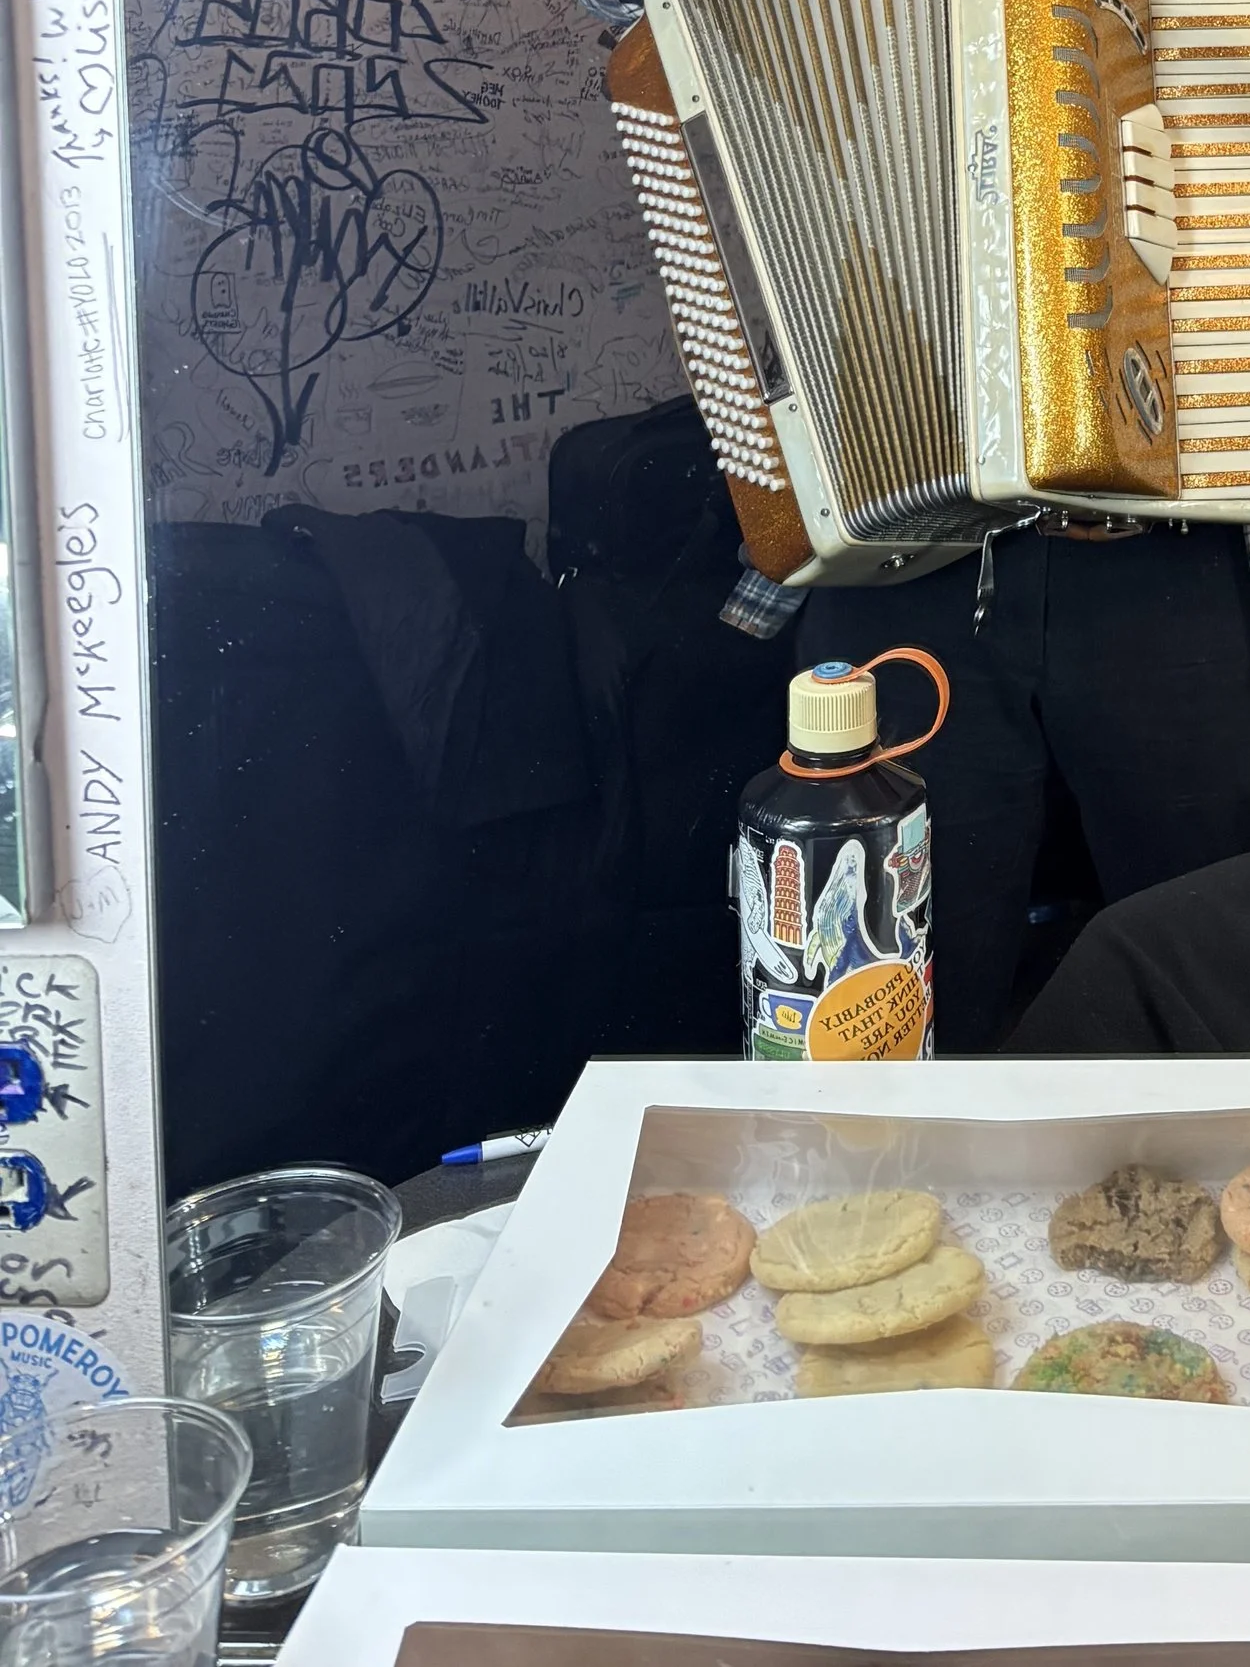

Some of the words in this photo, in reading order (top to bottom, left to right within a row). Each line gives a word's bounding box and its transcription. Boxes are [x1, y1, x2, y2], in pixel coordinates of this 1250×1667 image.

[79, 747, 124, 865] ANDY
[2, 1321, 130, 1399] POMEROY
[10, 1349, 53, 1369] MUSIC
